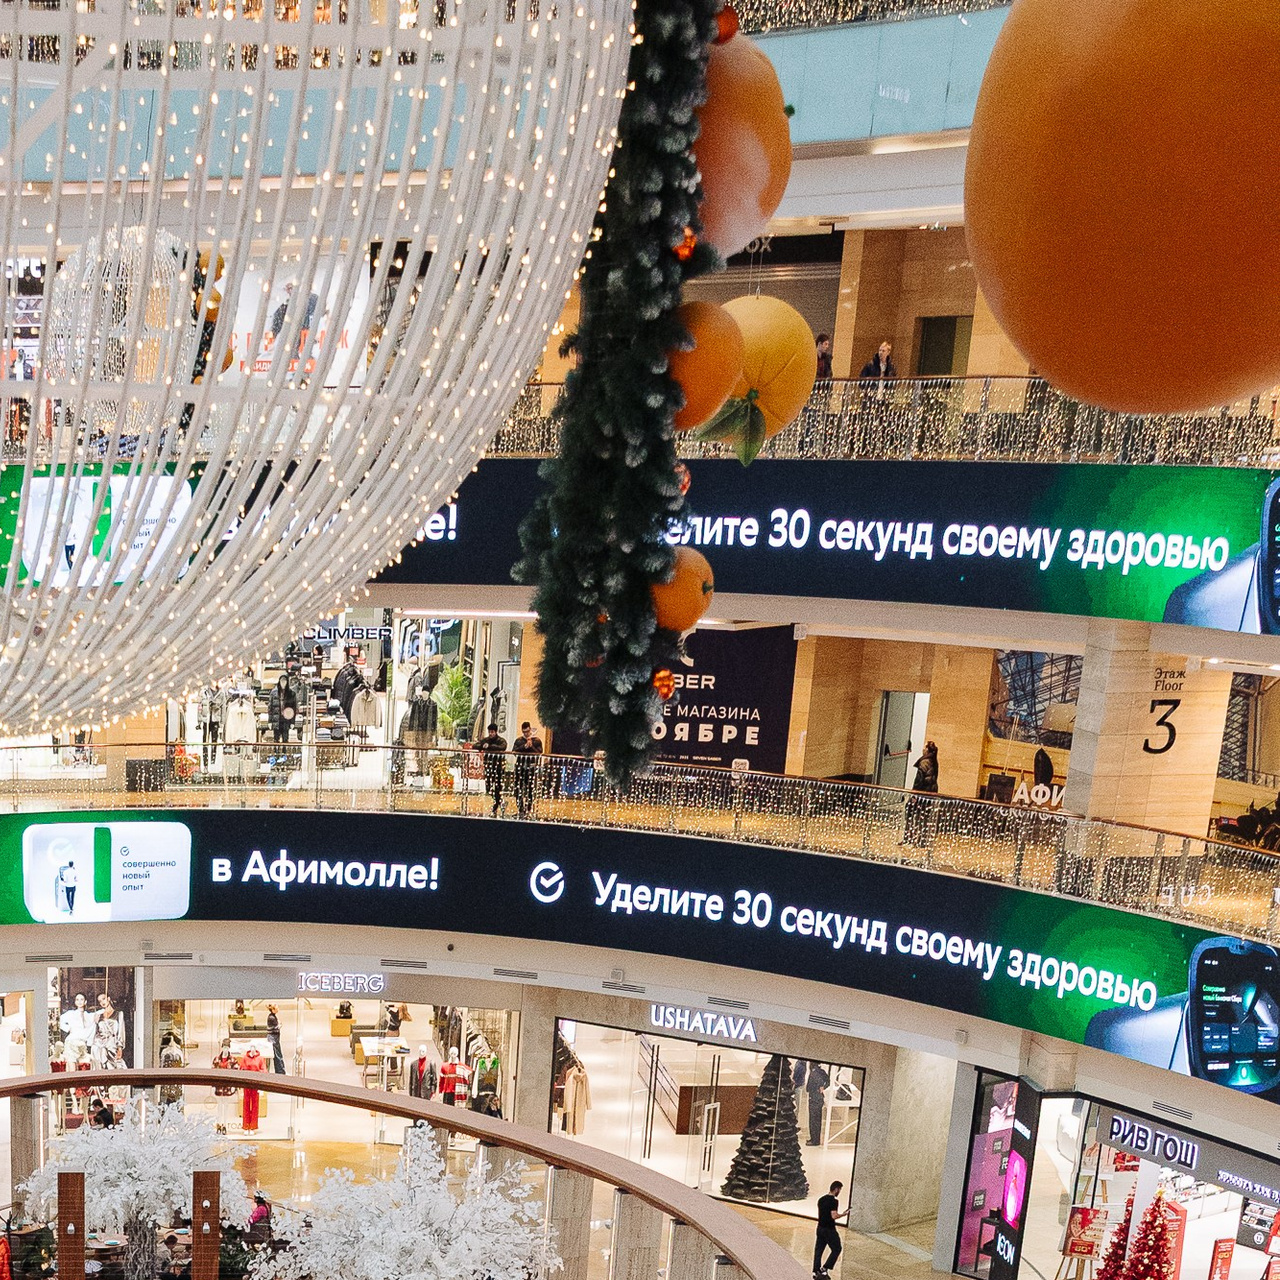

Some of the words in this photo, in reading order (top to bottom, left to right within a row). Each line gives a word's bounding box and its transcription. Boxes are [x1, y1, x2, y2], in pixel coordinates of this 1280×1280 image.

[665, 516, 760, 547] елите
[768, 508, 810, 548] 30
[818, 518, 934, 561] секунд
[942, 523, 1062, 570] своему
[1067, 529, 1229, 575] здоровью
[303, 626, 393, 641] CLIMBER
[673, 674, 716, 690] BER
[1154, 668, 1186, 680] Этаж
[1154, 680, 1184, 691] Floor
[677, 704, 761, 721] МАГАЗИНА
[651, 722, 760, 746] ОЯБРЕ
[1143, 699, 1181, 754] 3
[1012, 783, 1067, 807] АФИ
[122, 859, 177, 870] совершенно
[122, 870, 151, 880] новый
[211, 857, 232, 883] в
[241, 849, 439, 891] Афимолле!
[592, 871, 724, 922] Уделите
[732, 889, 773, 928] 30
[780, 905, 888, 954] секунд
[895, 925, 1002, 981] своему
[1007, 948, 1158, 1012] здоровью
[297, 972, 384, 994] ICEBERG
[651, 1004, 758, 1042] USHATAVA
[1110, 1115, 1153, 1150] РИВ
[1155, 1130, 1200, 1170] ГОШ
